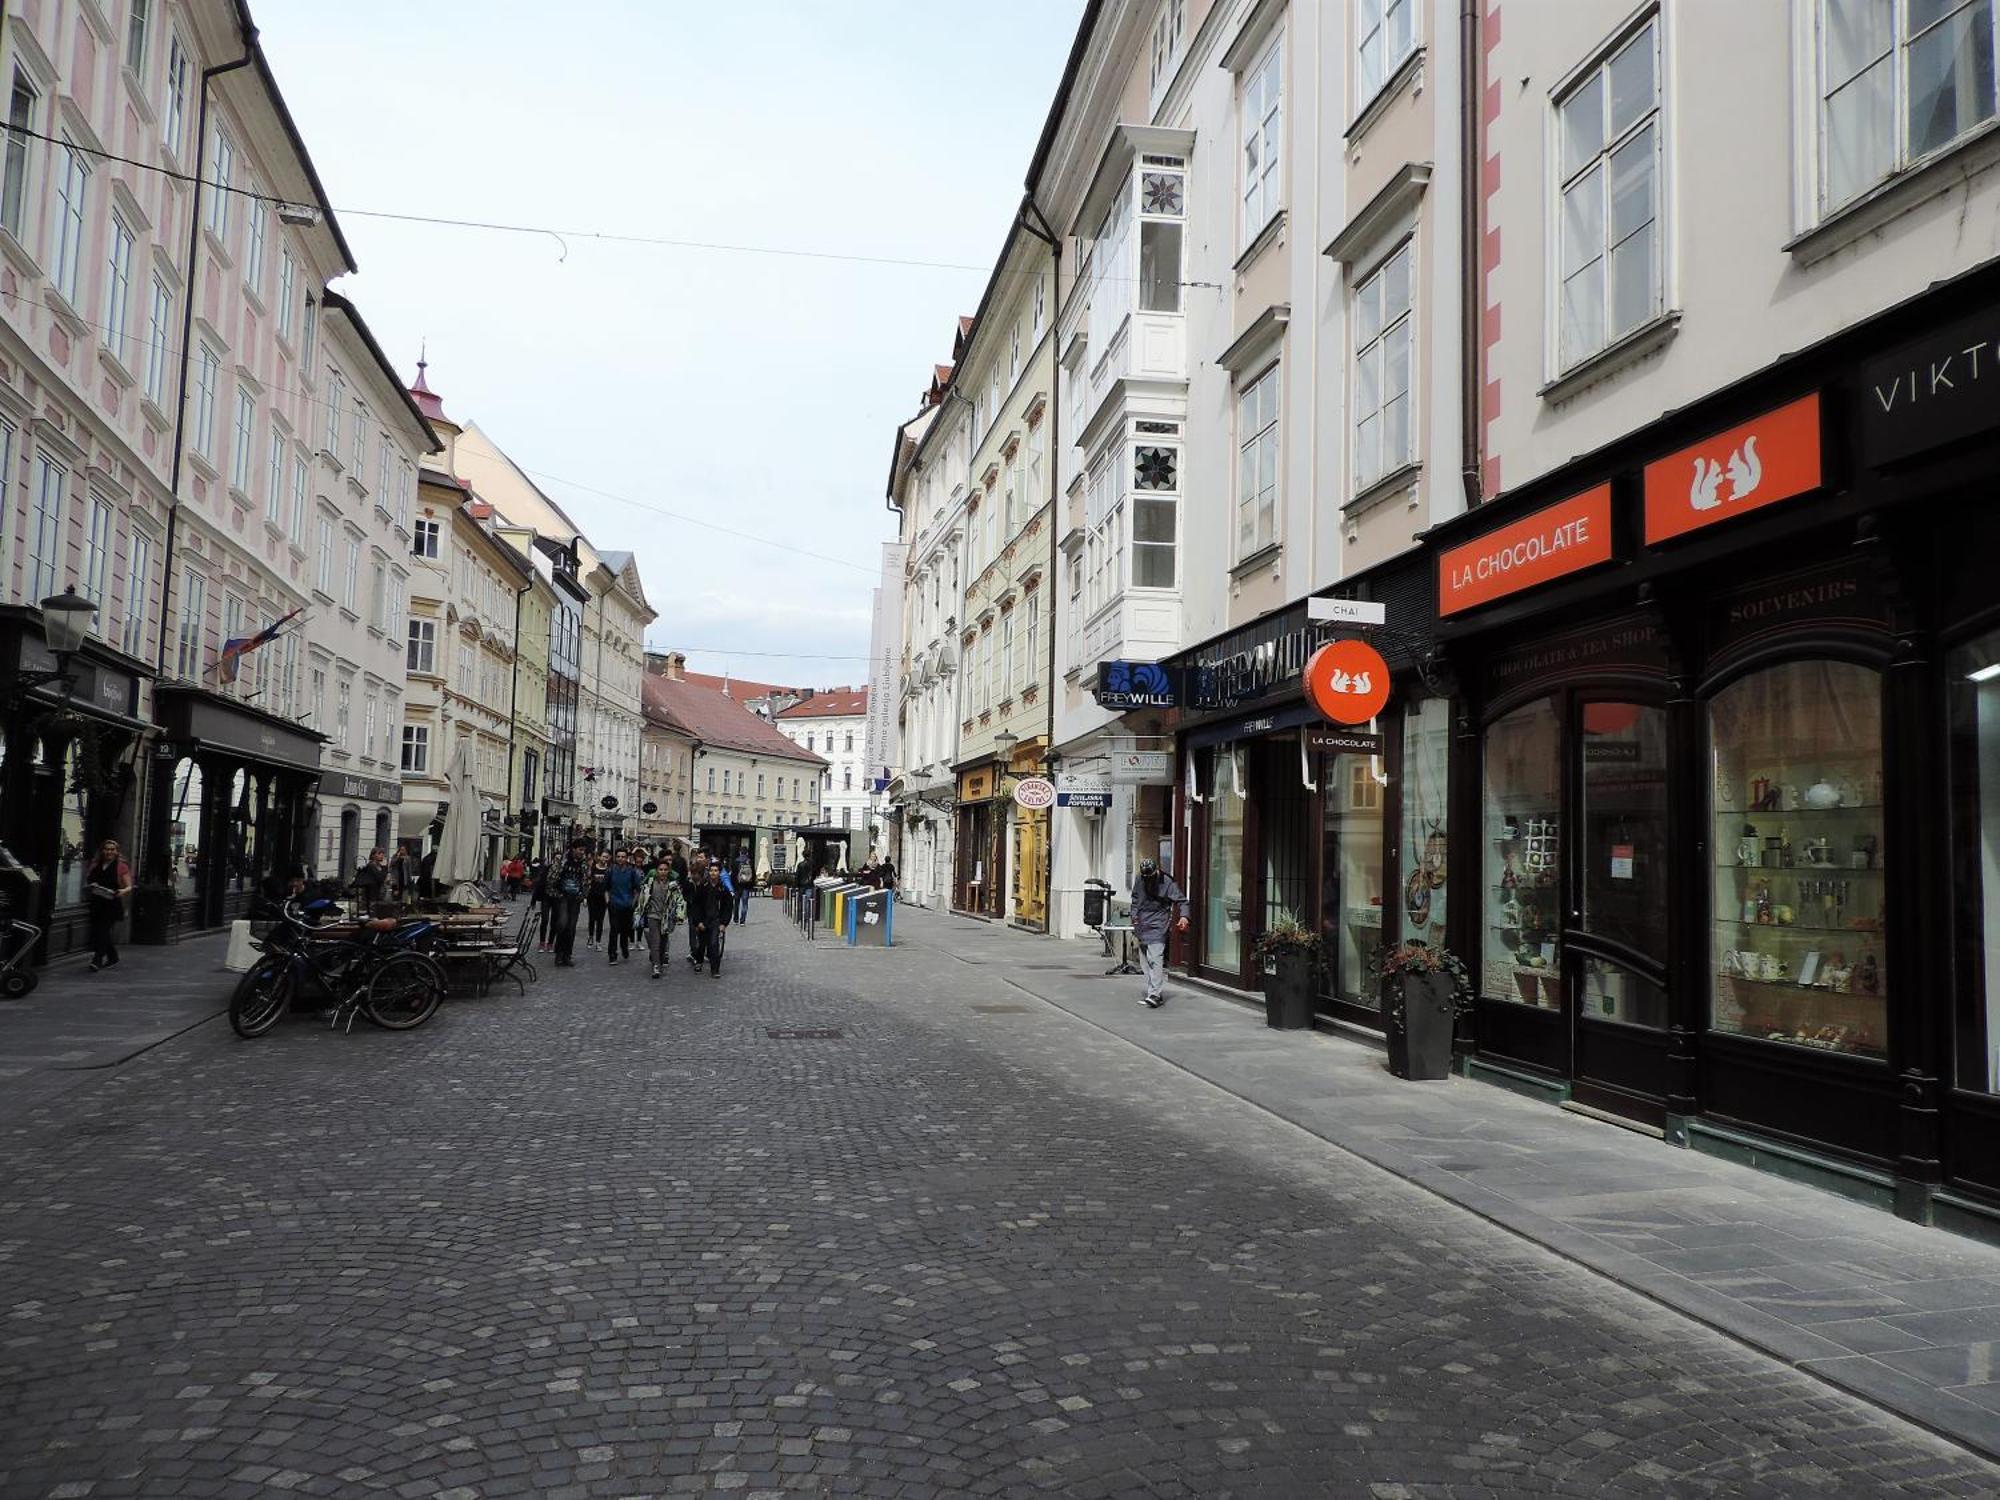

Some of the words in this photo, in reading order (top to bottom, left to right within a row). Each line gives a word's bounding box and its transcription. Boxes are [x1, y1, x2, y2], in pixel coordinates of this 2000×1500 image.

[1875, 341, 2000, 413] VIKT
[1452, 564, 1474, 590] LA
[1476, 517, 1590, 580] CHOCOLATE
[1332, 605, 1359, 617] CHAI
[1729, 579, 1857, 623] SOUVENIRS
[1611, 626, 1658, 650] SHOP
[1100, 691, 1175, 706] FREYWILLE
[1312, 736, 1324, 745] LA
[1324, 737, 1377, 749] CHOCOLATE
